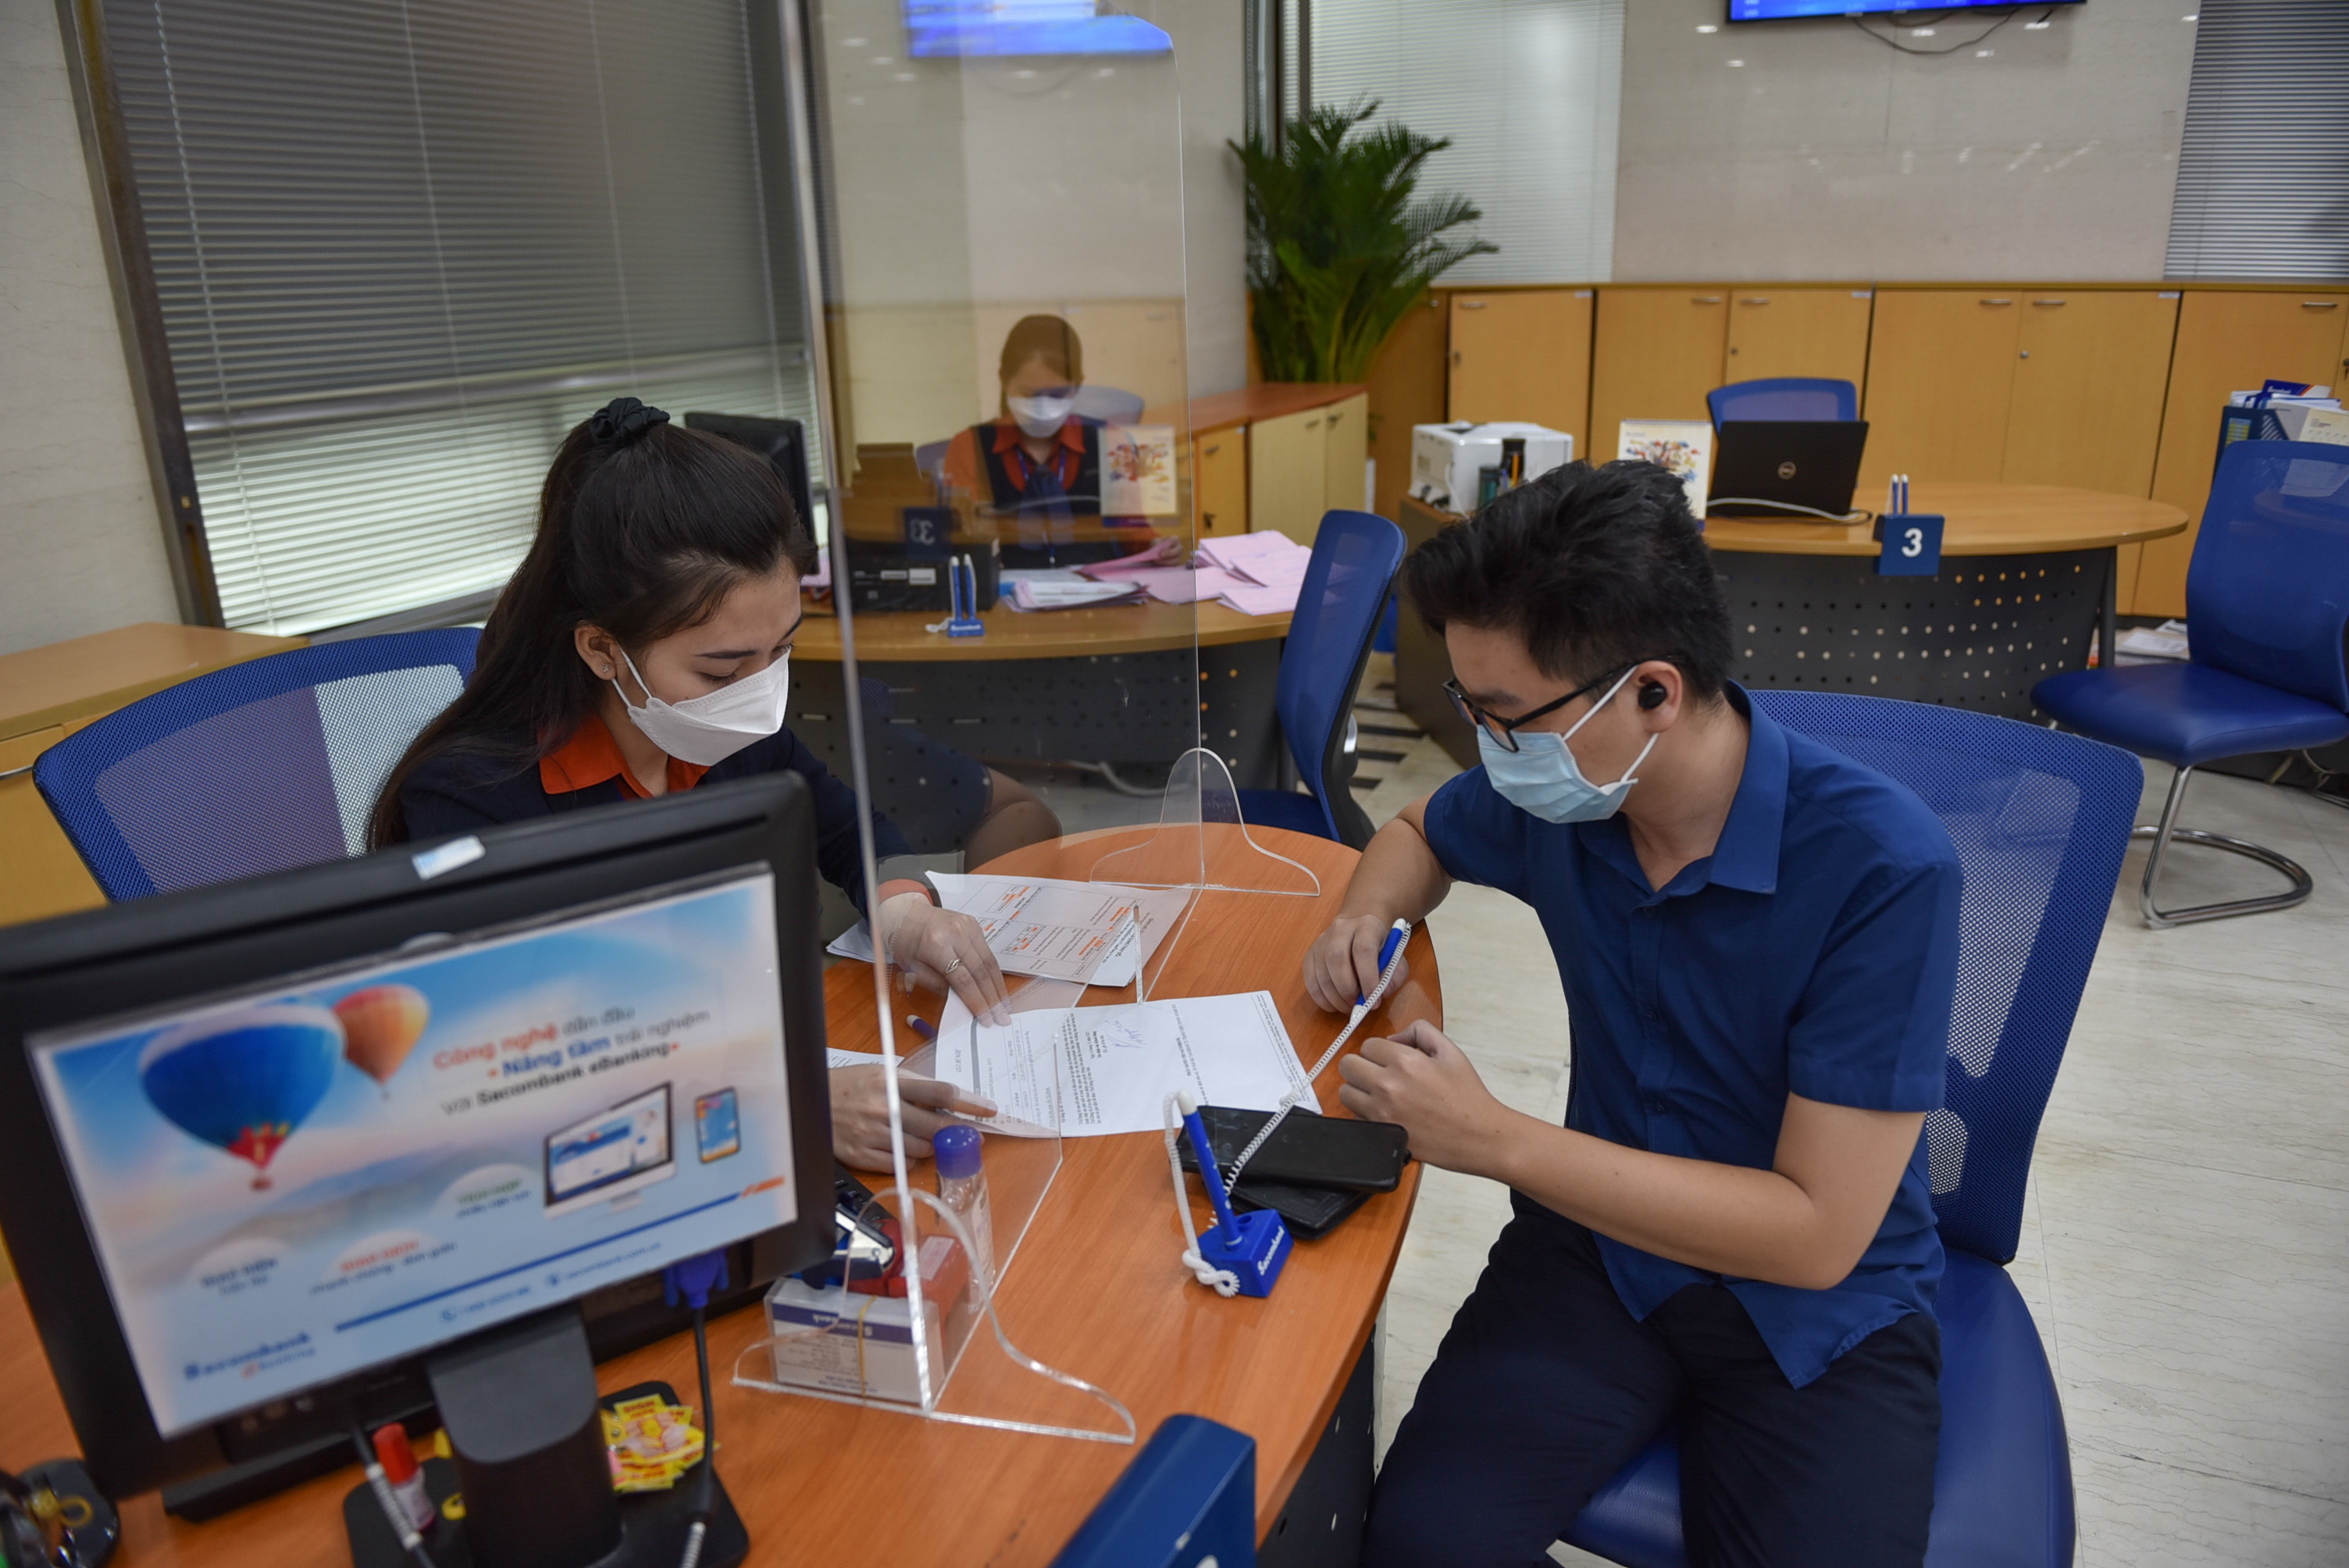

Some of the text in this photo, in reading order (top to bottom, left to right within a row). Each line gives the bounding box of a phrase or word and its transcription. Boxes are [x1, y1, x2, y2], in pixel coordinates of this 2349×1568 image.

[1902, 528, 1923, 558] 3
[501, 1022, 557, 1051] nghệ
[476, 1064, 584, 1106] Sacombank
[587, 1042, 670, 1074] eBanking
[1257, 1225, 1285, 1276] Sacombank
[184, 1332, 310, 1380] Sacombank
